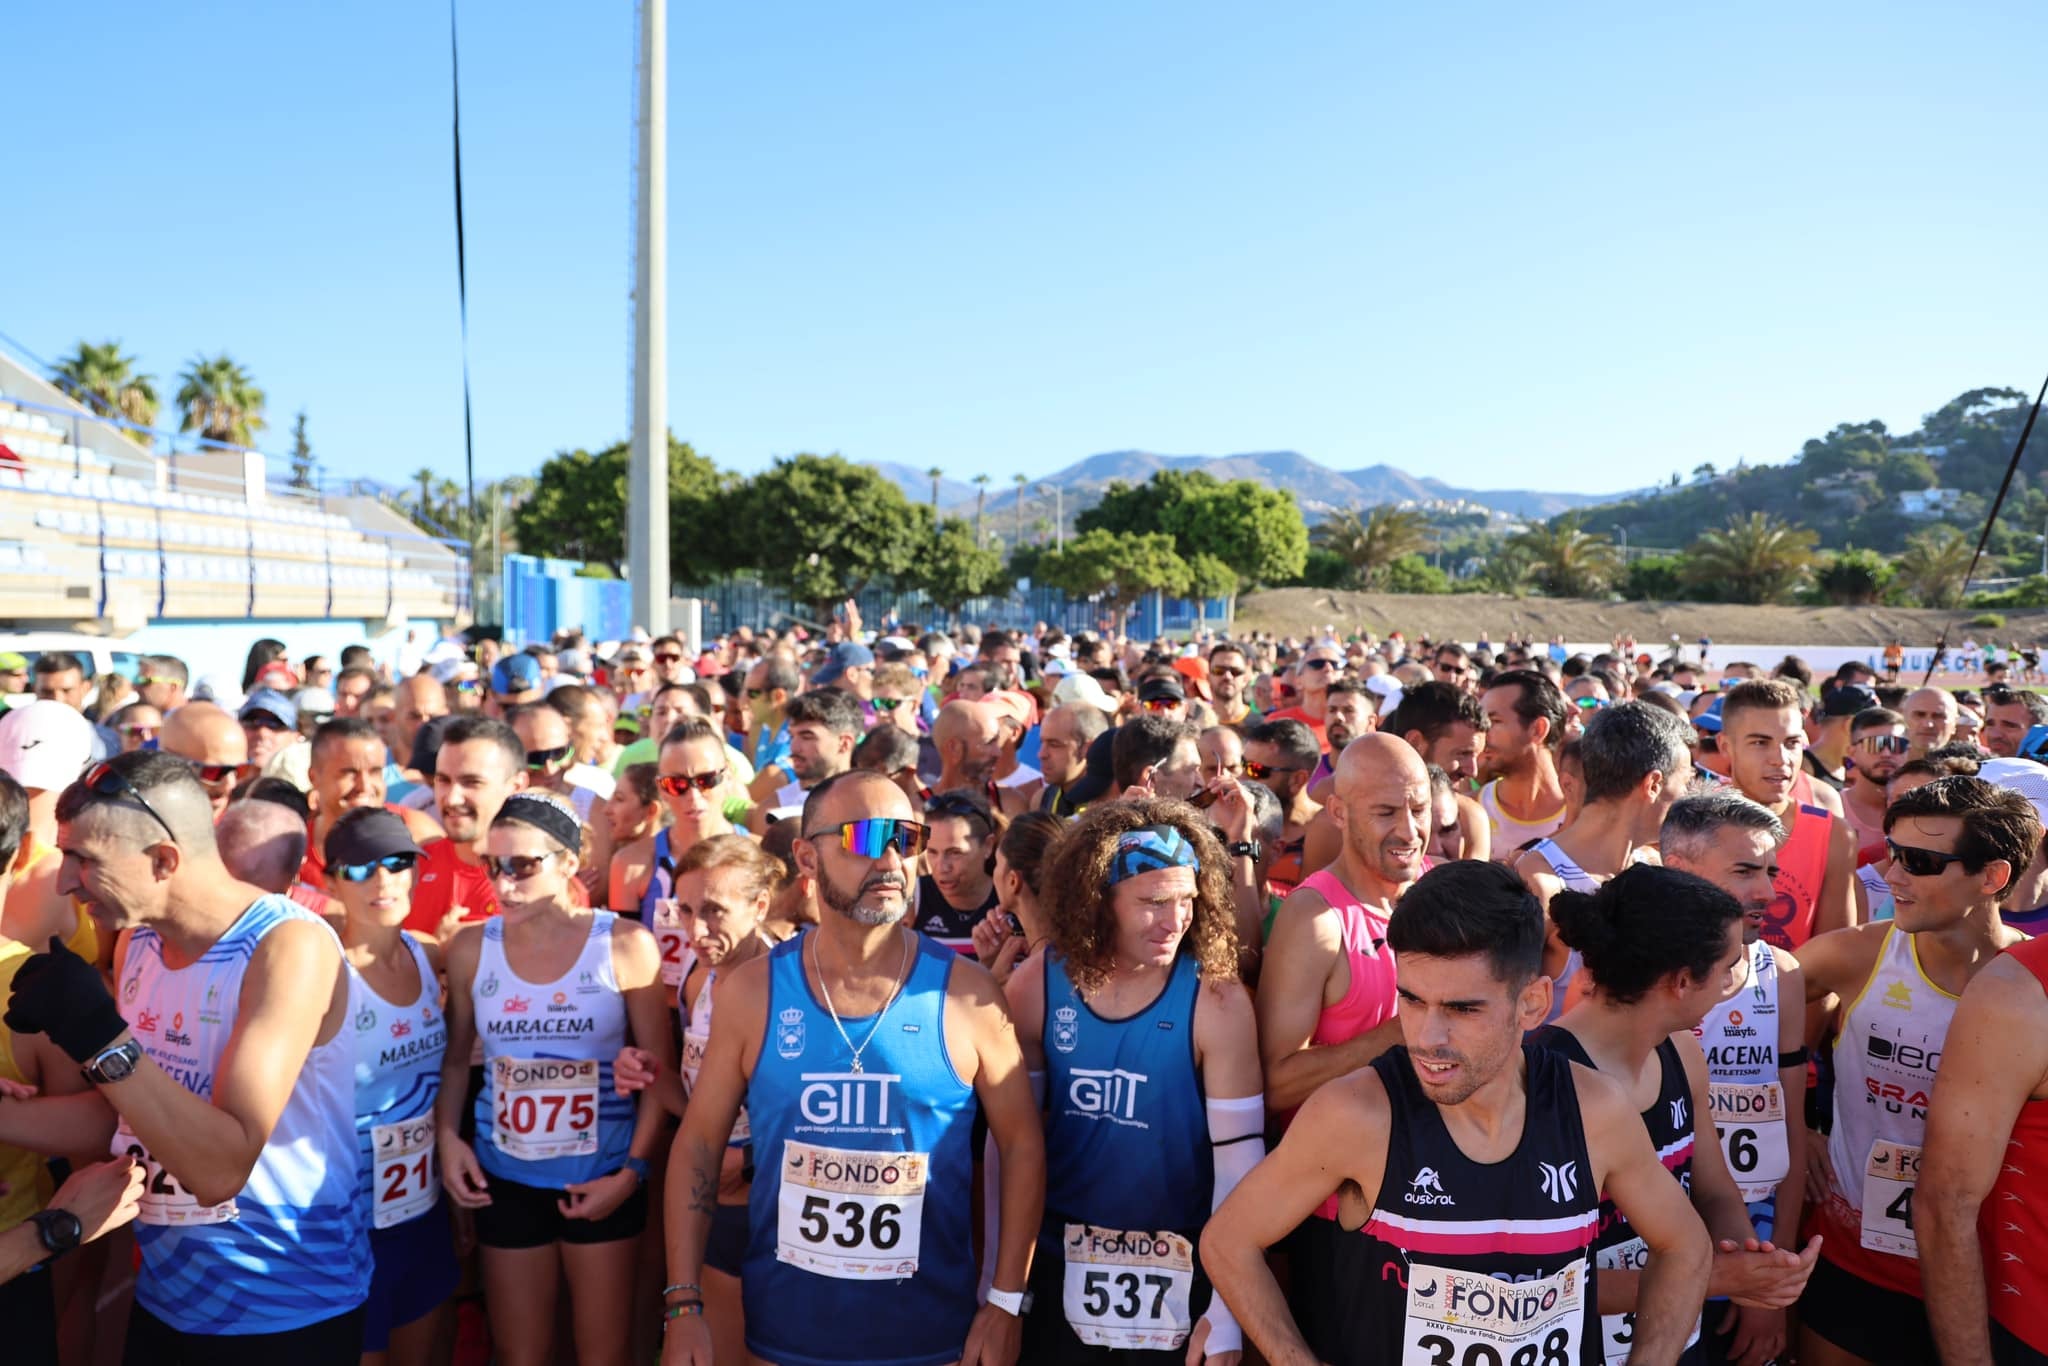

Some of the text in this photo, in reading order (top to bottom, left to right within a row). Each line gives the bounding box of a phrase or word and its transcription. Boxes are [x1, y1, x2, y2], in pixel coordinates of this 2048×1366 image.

[487, 1017, 594, 1034] MARACENA
[1703, 1045, 1773, 1065] ACENA
[1711, 1068, 1761, 1076] ATLETISMO
[800, 1073, 901, 1125] GIIT
[1069, 1067, 1148, 1118] GIIT
[1866, 1077, 1928, 1107] GRA
[1867, 1093, 1927, 1120] RUN
[812, 1158, 900, 1184] FONDO
[1404, 1192, 1456, 1205] austral
[1885, 1187, 1914, 1230] 4
[799, 1195, 901, 1250] 536
[1092, 1237, 1170, 1256] FONDO
[1624, 1241, 1648, 1254] GRA
[1083, 1271, 1173, 1320] 537
[1453, 1276, 1495, 1294] GRAN
[1499, 1285, 1546, 1300] PREMIO
[1451, 1286, 1558, 1322] FONDO
[1426, 1320, 1445, 1331] XXXV
[1446, 1323, 1468, 1335] Prueba
[1469, 1328, 1477, 1336] de
[1478, 1330, 1496, 1341] Fondo
[1612, 1312, 1637, 1344] 3
[1417, 1327, 1569, 1366] 3088
